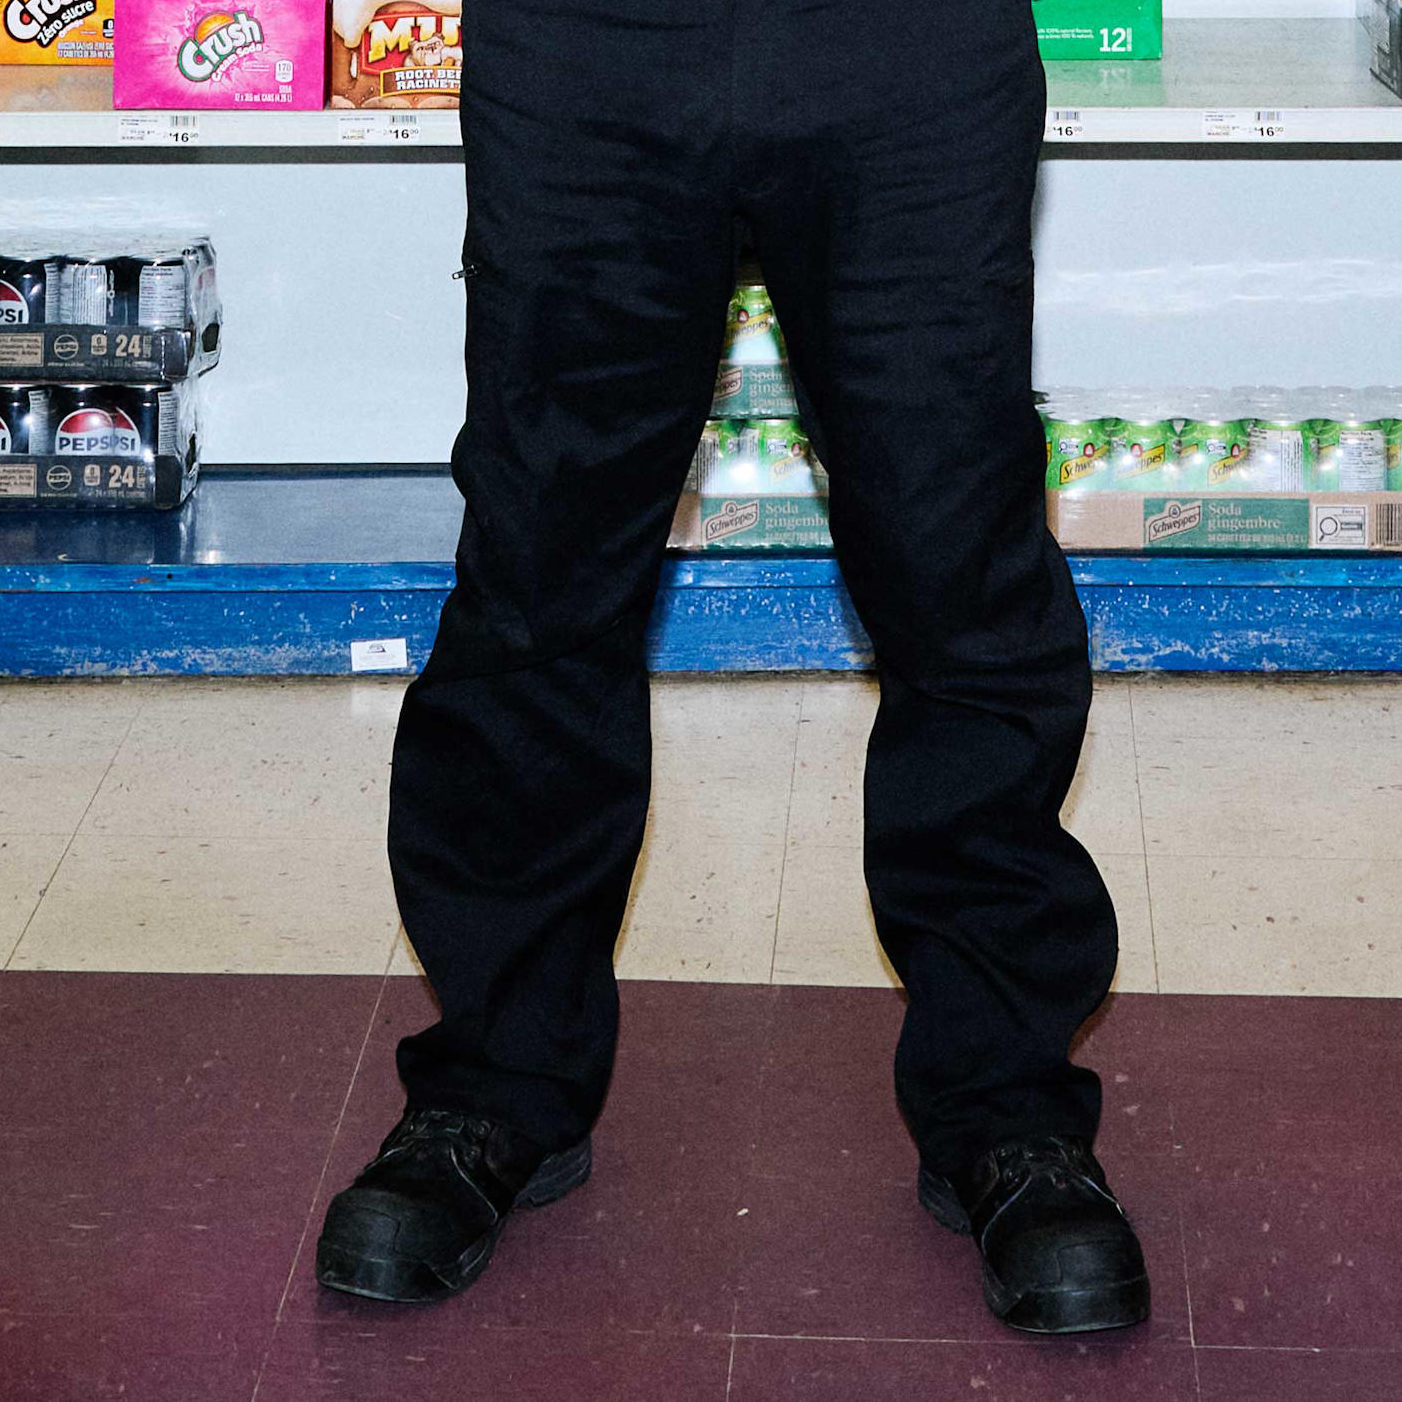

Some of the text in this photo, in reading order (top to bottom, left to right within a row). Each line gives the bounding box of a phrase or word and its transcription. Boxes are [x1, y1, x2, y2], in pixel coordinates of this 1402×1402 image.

[181, 12, 262, 78] Crush
[395, 70, 434, 80] ROOT
[115, 335, 141, 357] 24
[109, 465, 135, 487] 24
[1208, 504, 1242, 516] Soda
[1208, 517, 1281, 531] gingembre
